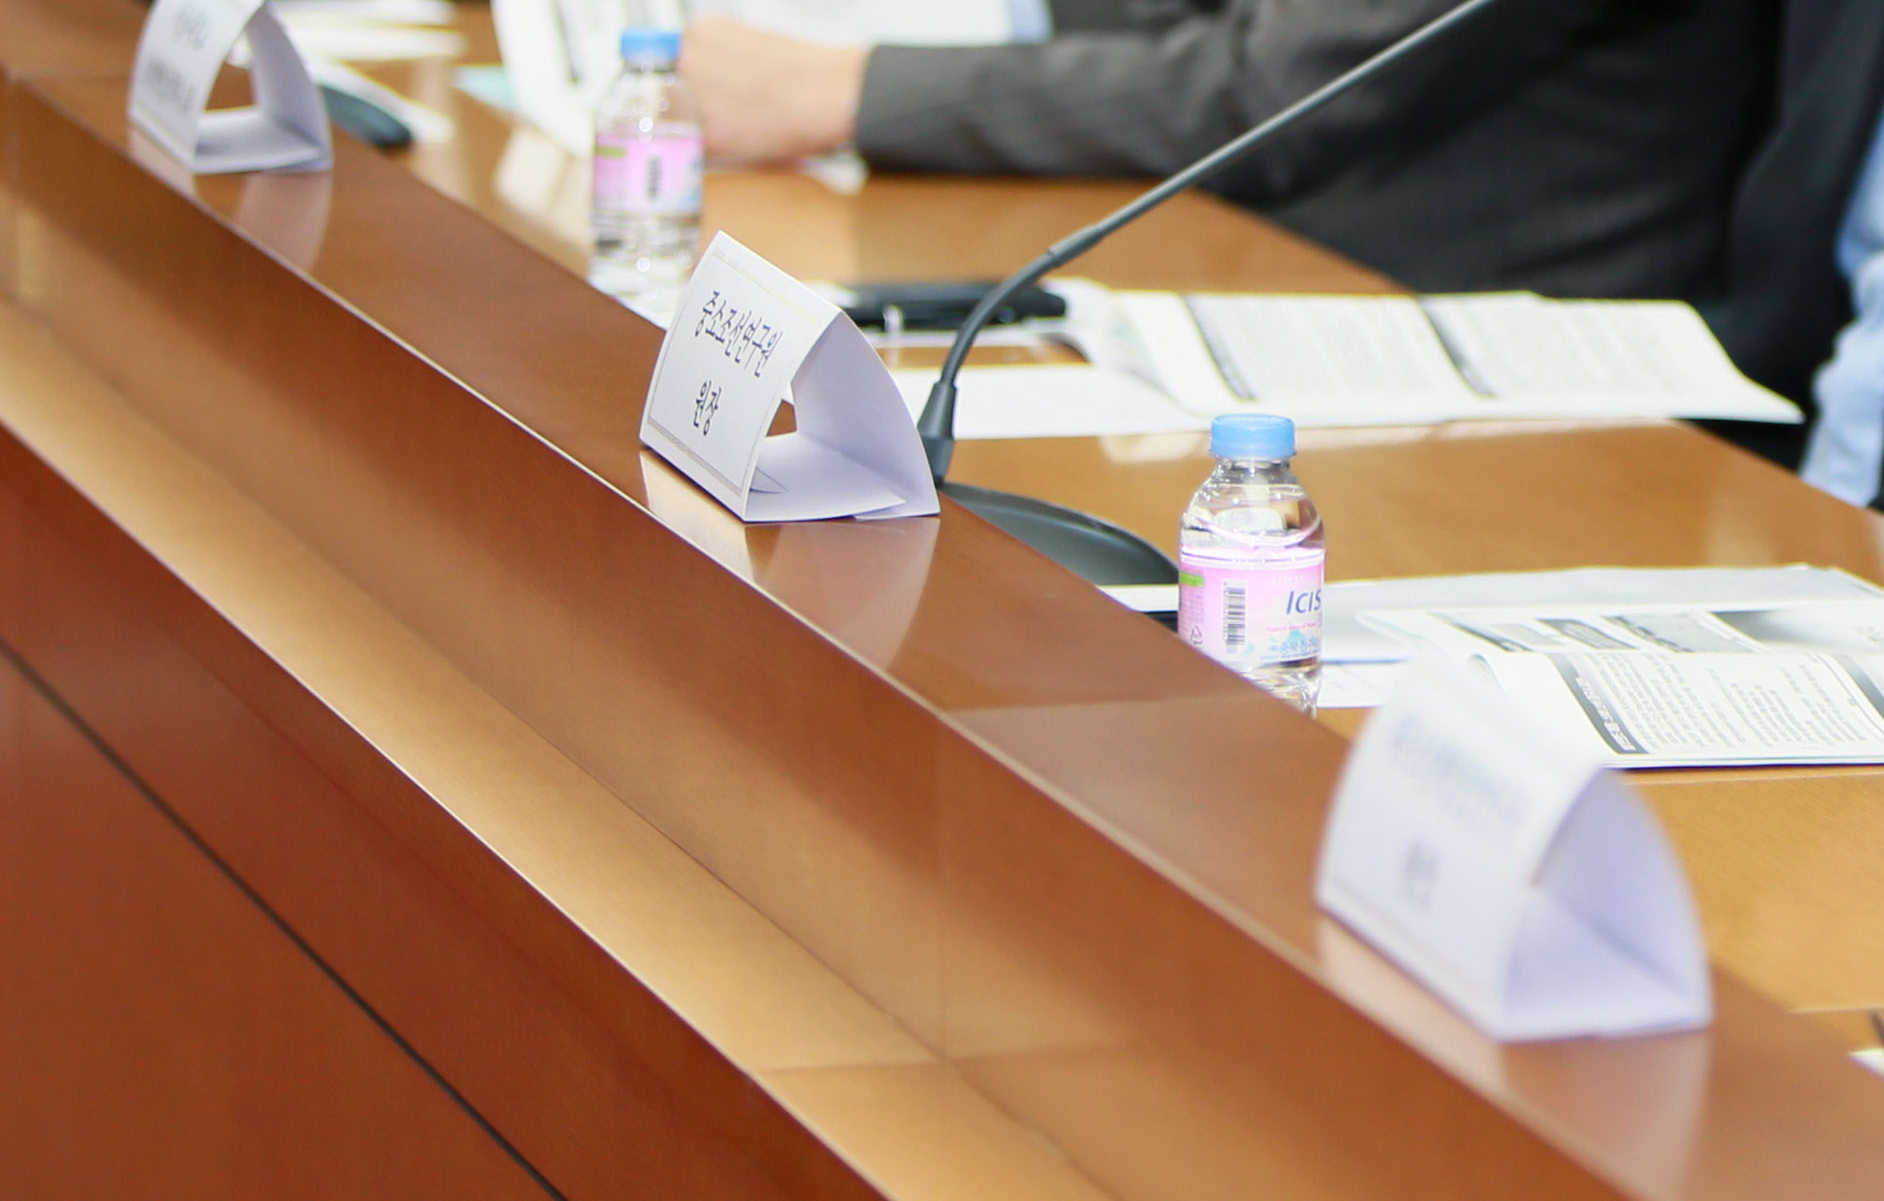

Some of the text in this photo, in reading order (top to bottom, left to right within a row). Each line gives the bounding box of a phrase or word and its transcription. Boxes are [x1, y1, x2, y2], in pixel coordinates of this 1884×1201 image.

[695, 290, 783, 378] 중소조선연구원
[693, 380, 722, 436] 원장
[1286, 588, 1322, 615] ICIS
